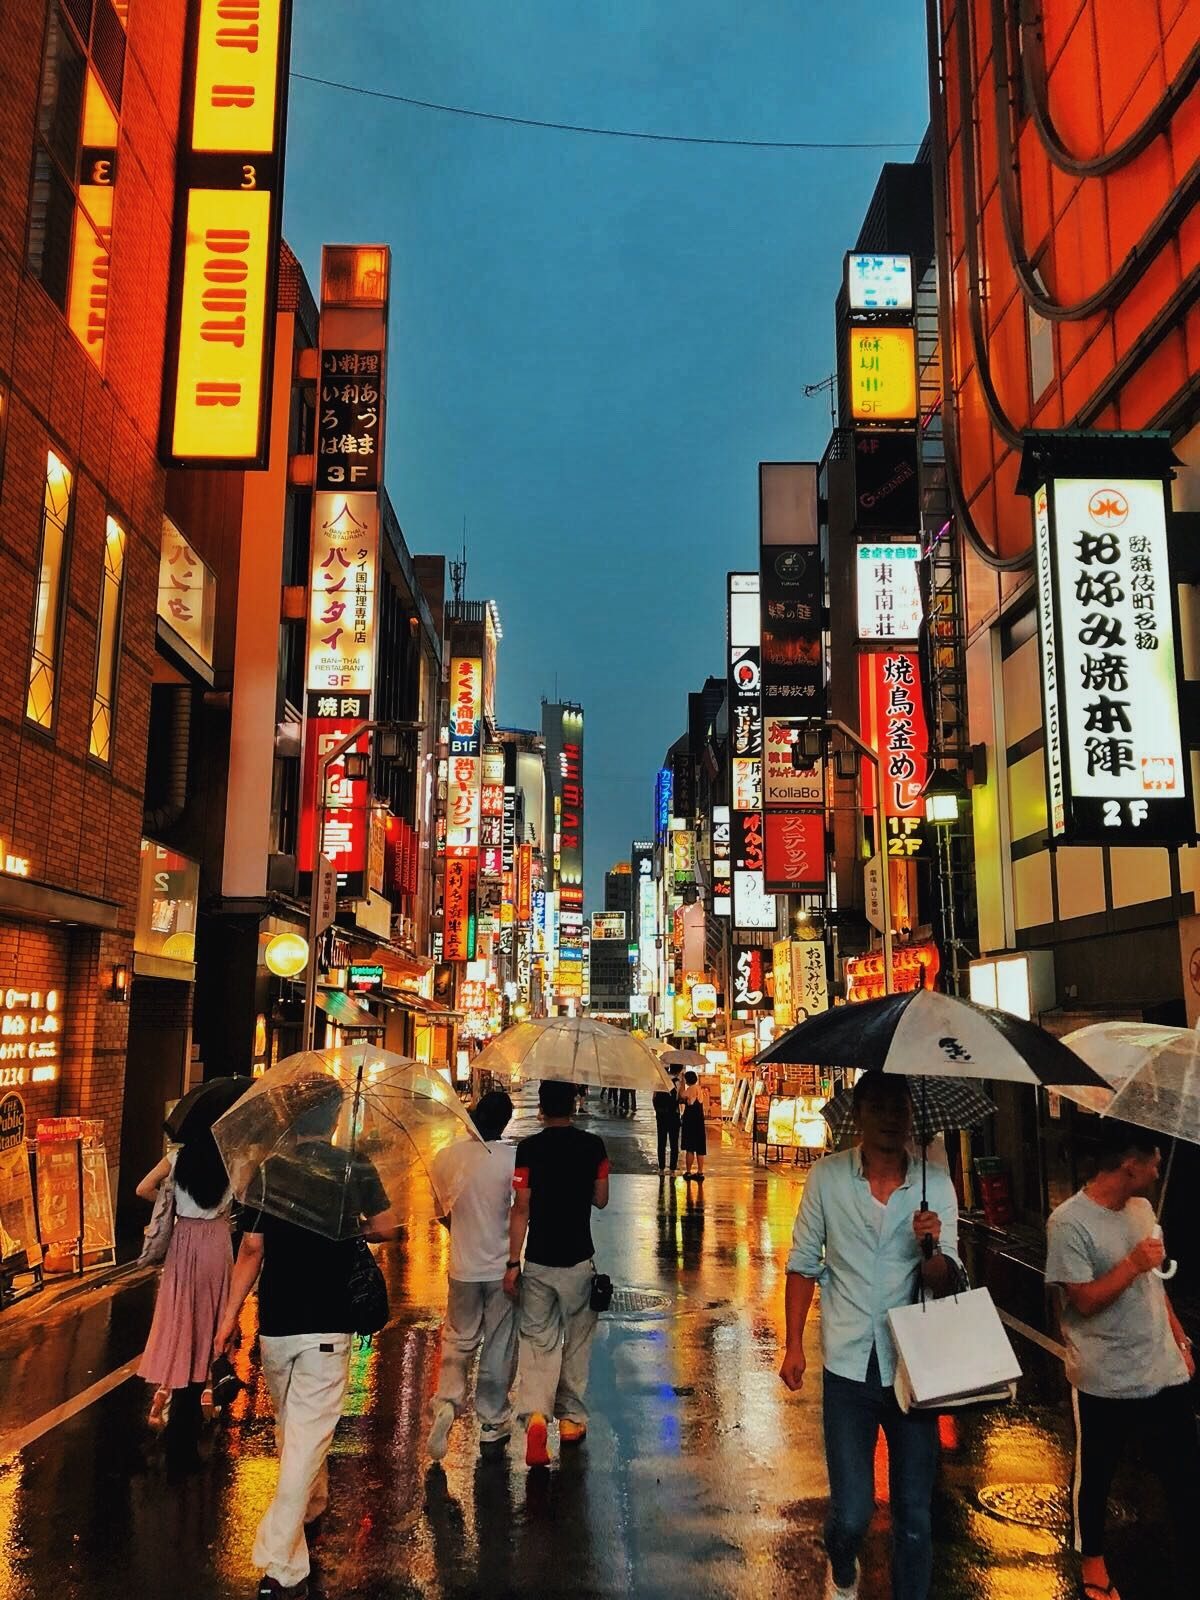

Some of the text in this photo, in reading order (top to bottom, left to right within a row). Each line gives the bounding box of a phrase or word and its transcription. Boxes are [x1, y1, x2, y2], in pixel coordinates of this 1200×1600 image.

[240, 164, 257, 189] 3
[195, 229, 251, 407] DOUTR
[324, 354, 378, 374] 小料理
[861, 400, 882, 413] 5F
[327, 466, 369, 482] 3F
[320, 547, 351, 650] バンタイ
[354, 549, 368, 643] タイ国料理専門店
[873, 563, 895, 636] 東南荘
[1039, 525, 1062, 799] OKONOMIYAKI HONJIN
[1073, 530, 1136, 777] お好み焼本陣
[327, 675, 351, 686] 3F
[318, 697, 361, 717] 焼肉
[456, 661, 474, 736] まぐろ商店
[884, 655, 915, 810] 焼鳥釜めし
[451, 741, 477, 752] B1F
[769, 787, 820, 798] KollaBo
[1103, 799, 1149, 827] 2F
[888, 817, 921, 834] 1F
[453, 847, 470, 857] 4F
[781, 816, 809, 880] ステップ
[888, 839, 923, 855] 2F
[0, 1110, 24, 1132] ublic
[0, 1126, 21, 1150] tand
